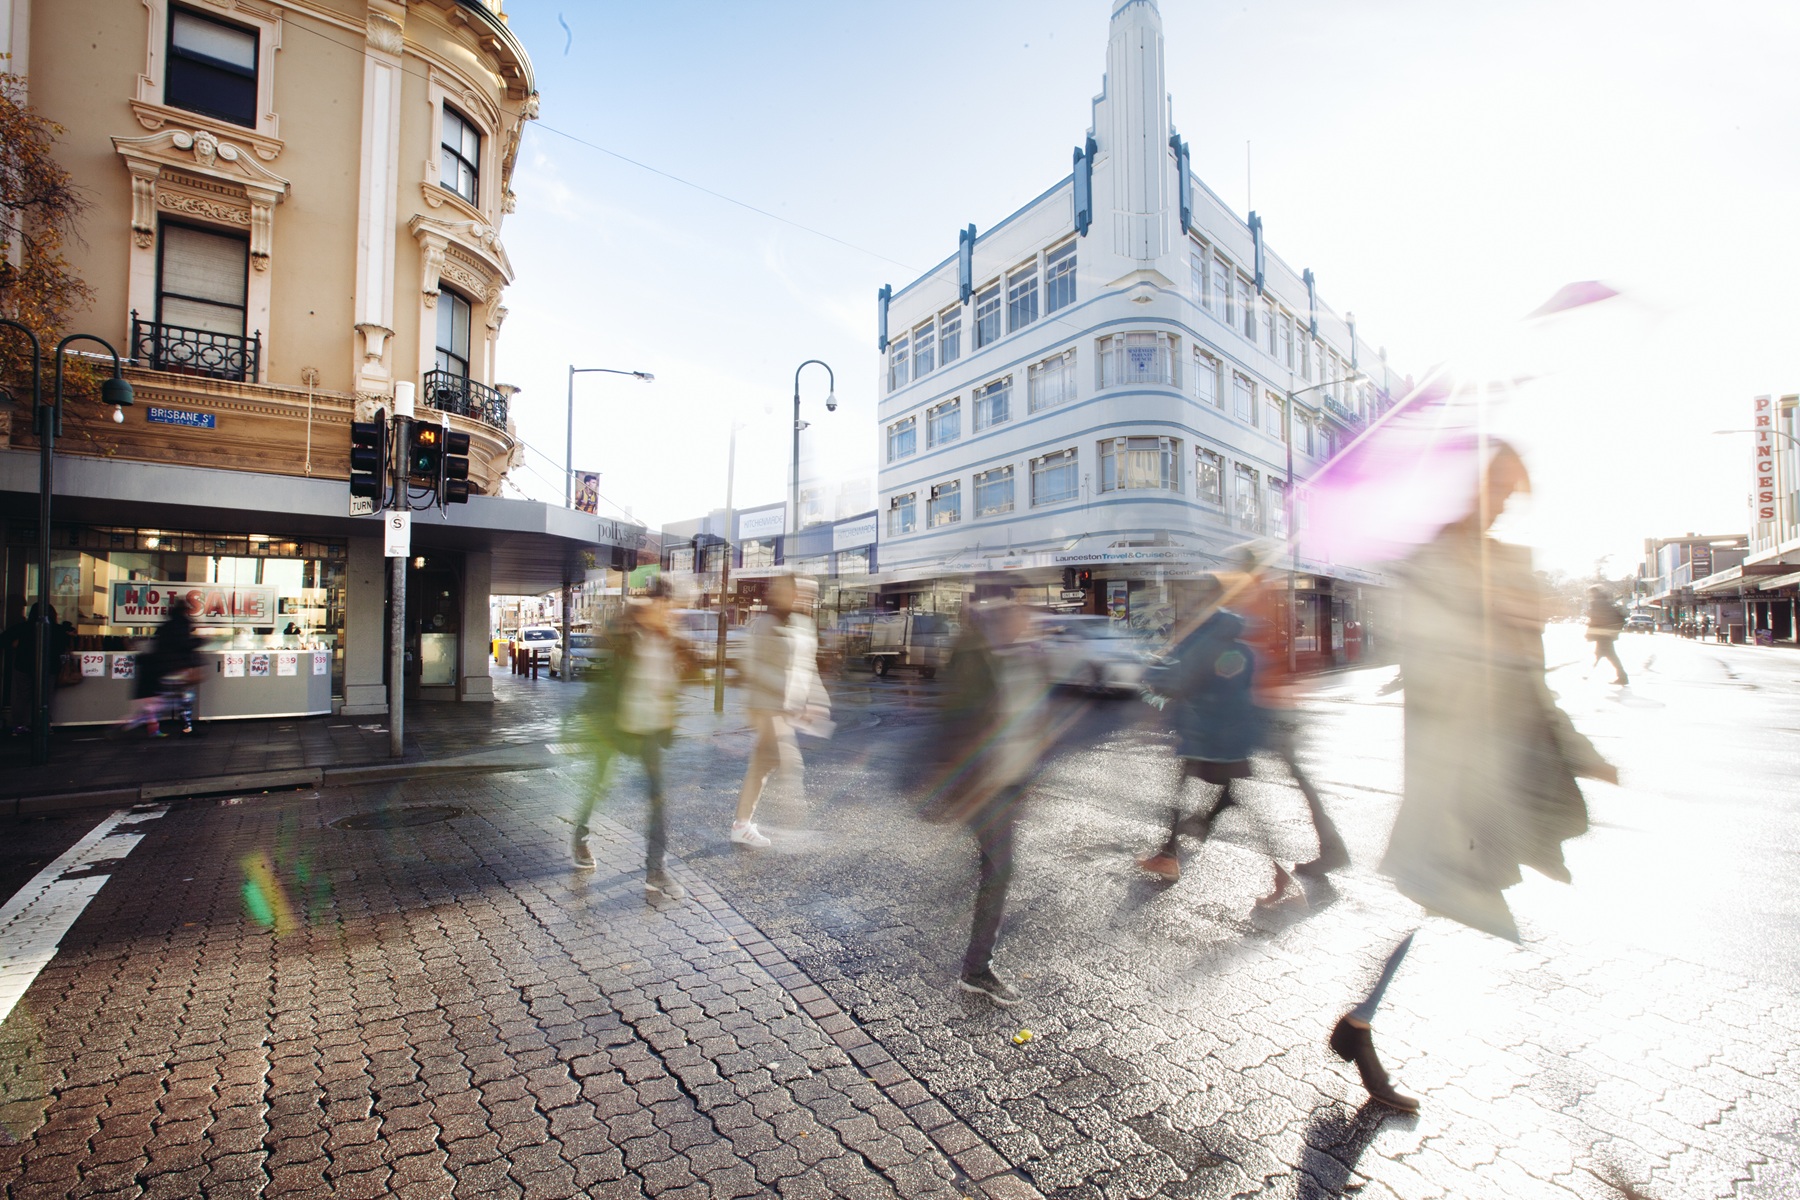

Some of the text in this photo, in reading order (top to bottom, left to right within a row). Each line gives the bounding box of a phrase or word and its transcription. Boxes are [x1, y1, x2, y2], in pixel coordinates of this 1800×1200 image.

[151, 408, 199, 422] BRISBANE
[1756, 399, 1774, 518] PRINCESS
[352, 501, 372, 511] TURN
[393, 519, 402, 528] S
[598, 521, 622, 546] polly
[125, 589, 177, 605] HOT
[186, 589, 265, 618] SALE
[83, 655, 104, 664] $79
